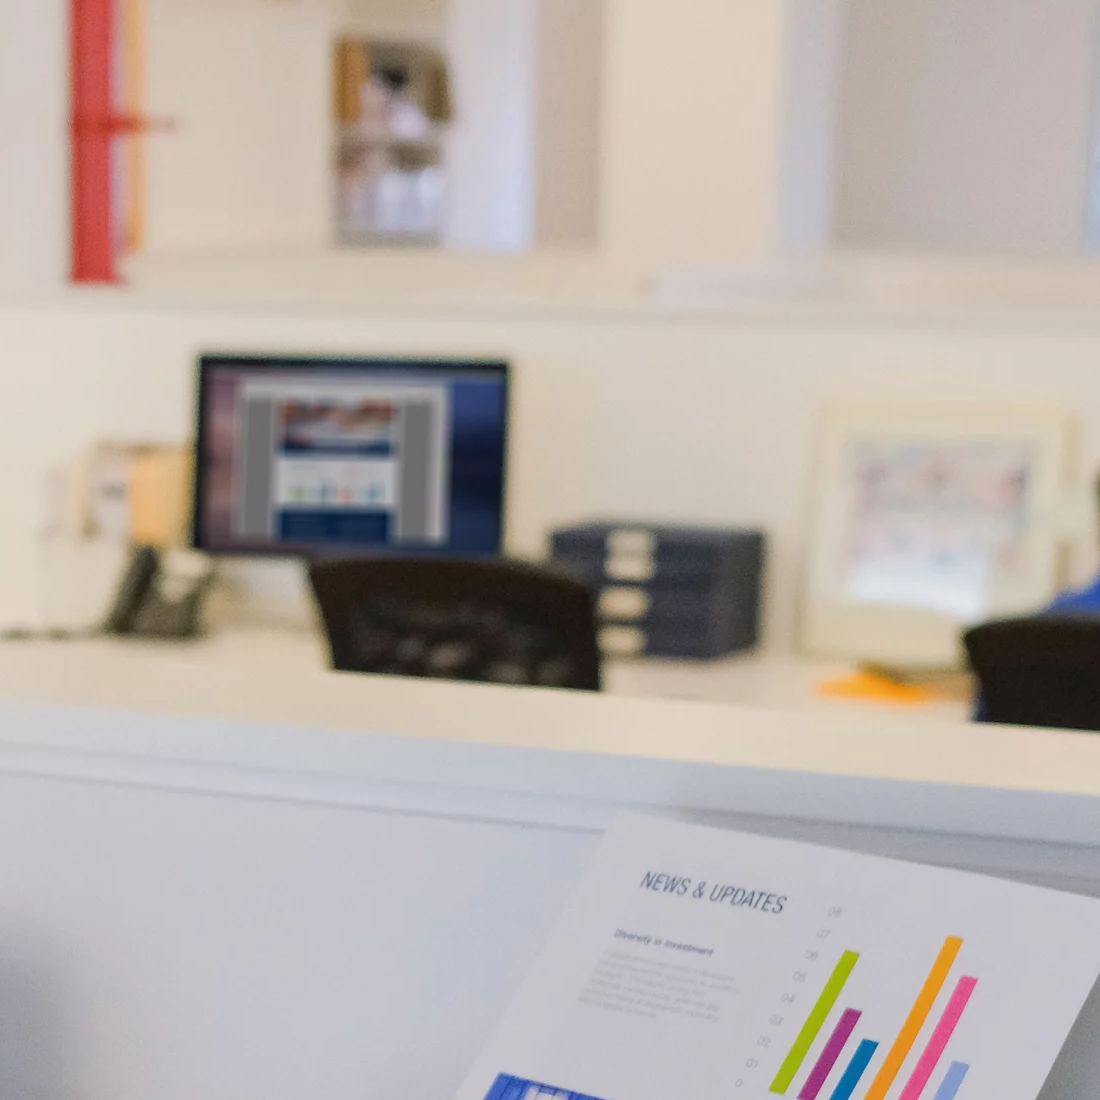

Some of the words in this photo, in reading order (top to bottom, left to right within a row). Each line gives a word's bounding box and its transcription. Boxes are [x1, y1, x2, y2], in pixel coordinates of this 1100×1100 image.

[640, 871, 691, 896] NEWS
[692, 880, 706, 899] &
[709, 884, 787, 914] UPDATES
[757, 1036, 771, 1047] 02
[746, 1058, 758, 1068] 01
